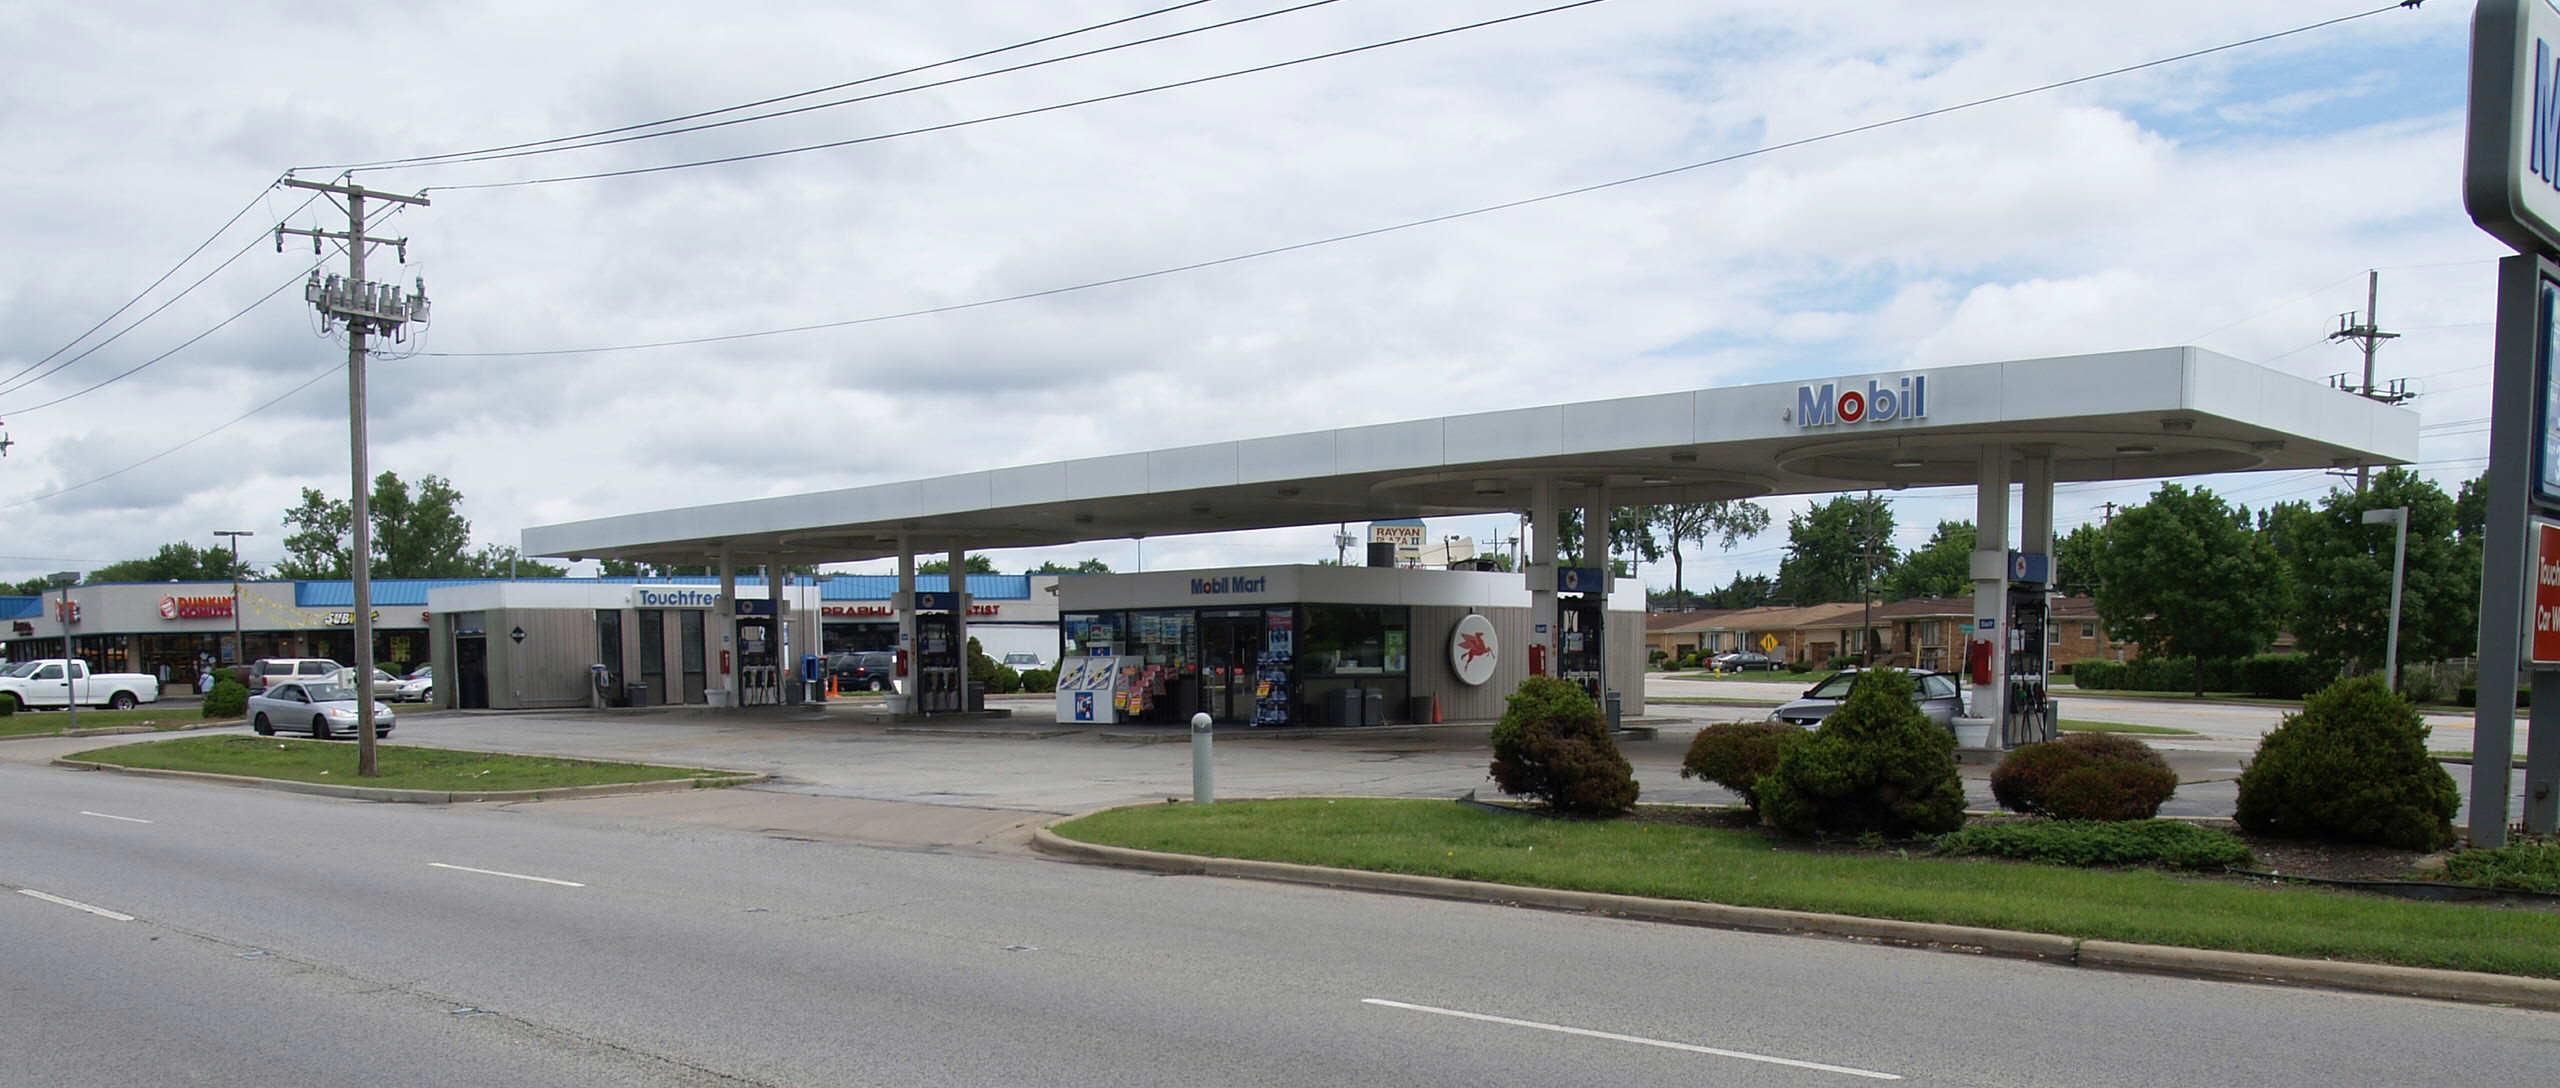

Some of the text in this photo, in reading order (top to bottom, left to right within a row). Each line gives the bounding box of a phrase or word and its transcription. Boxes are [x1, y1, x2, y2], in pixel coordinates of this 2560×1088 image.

[1798, 375, 1928, 428] Mobil
[1376, 527, 1420, 537] RAYYAN
[1191, 576, 1266, 594] Mobil Mart
[2537, 605, 2552, 632] Car
